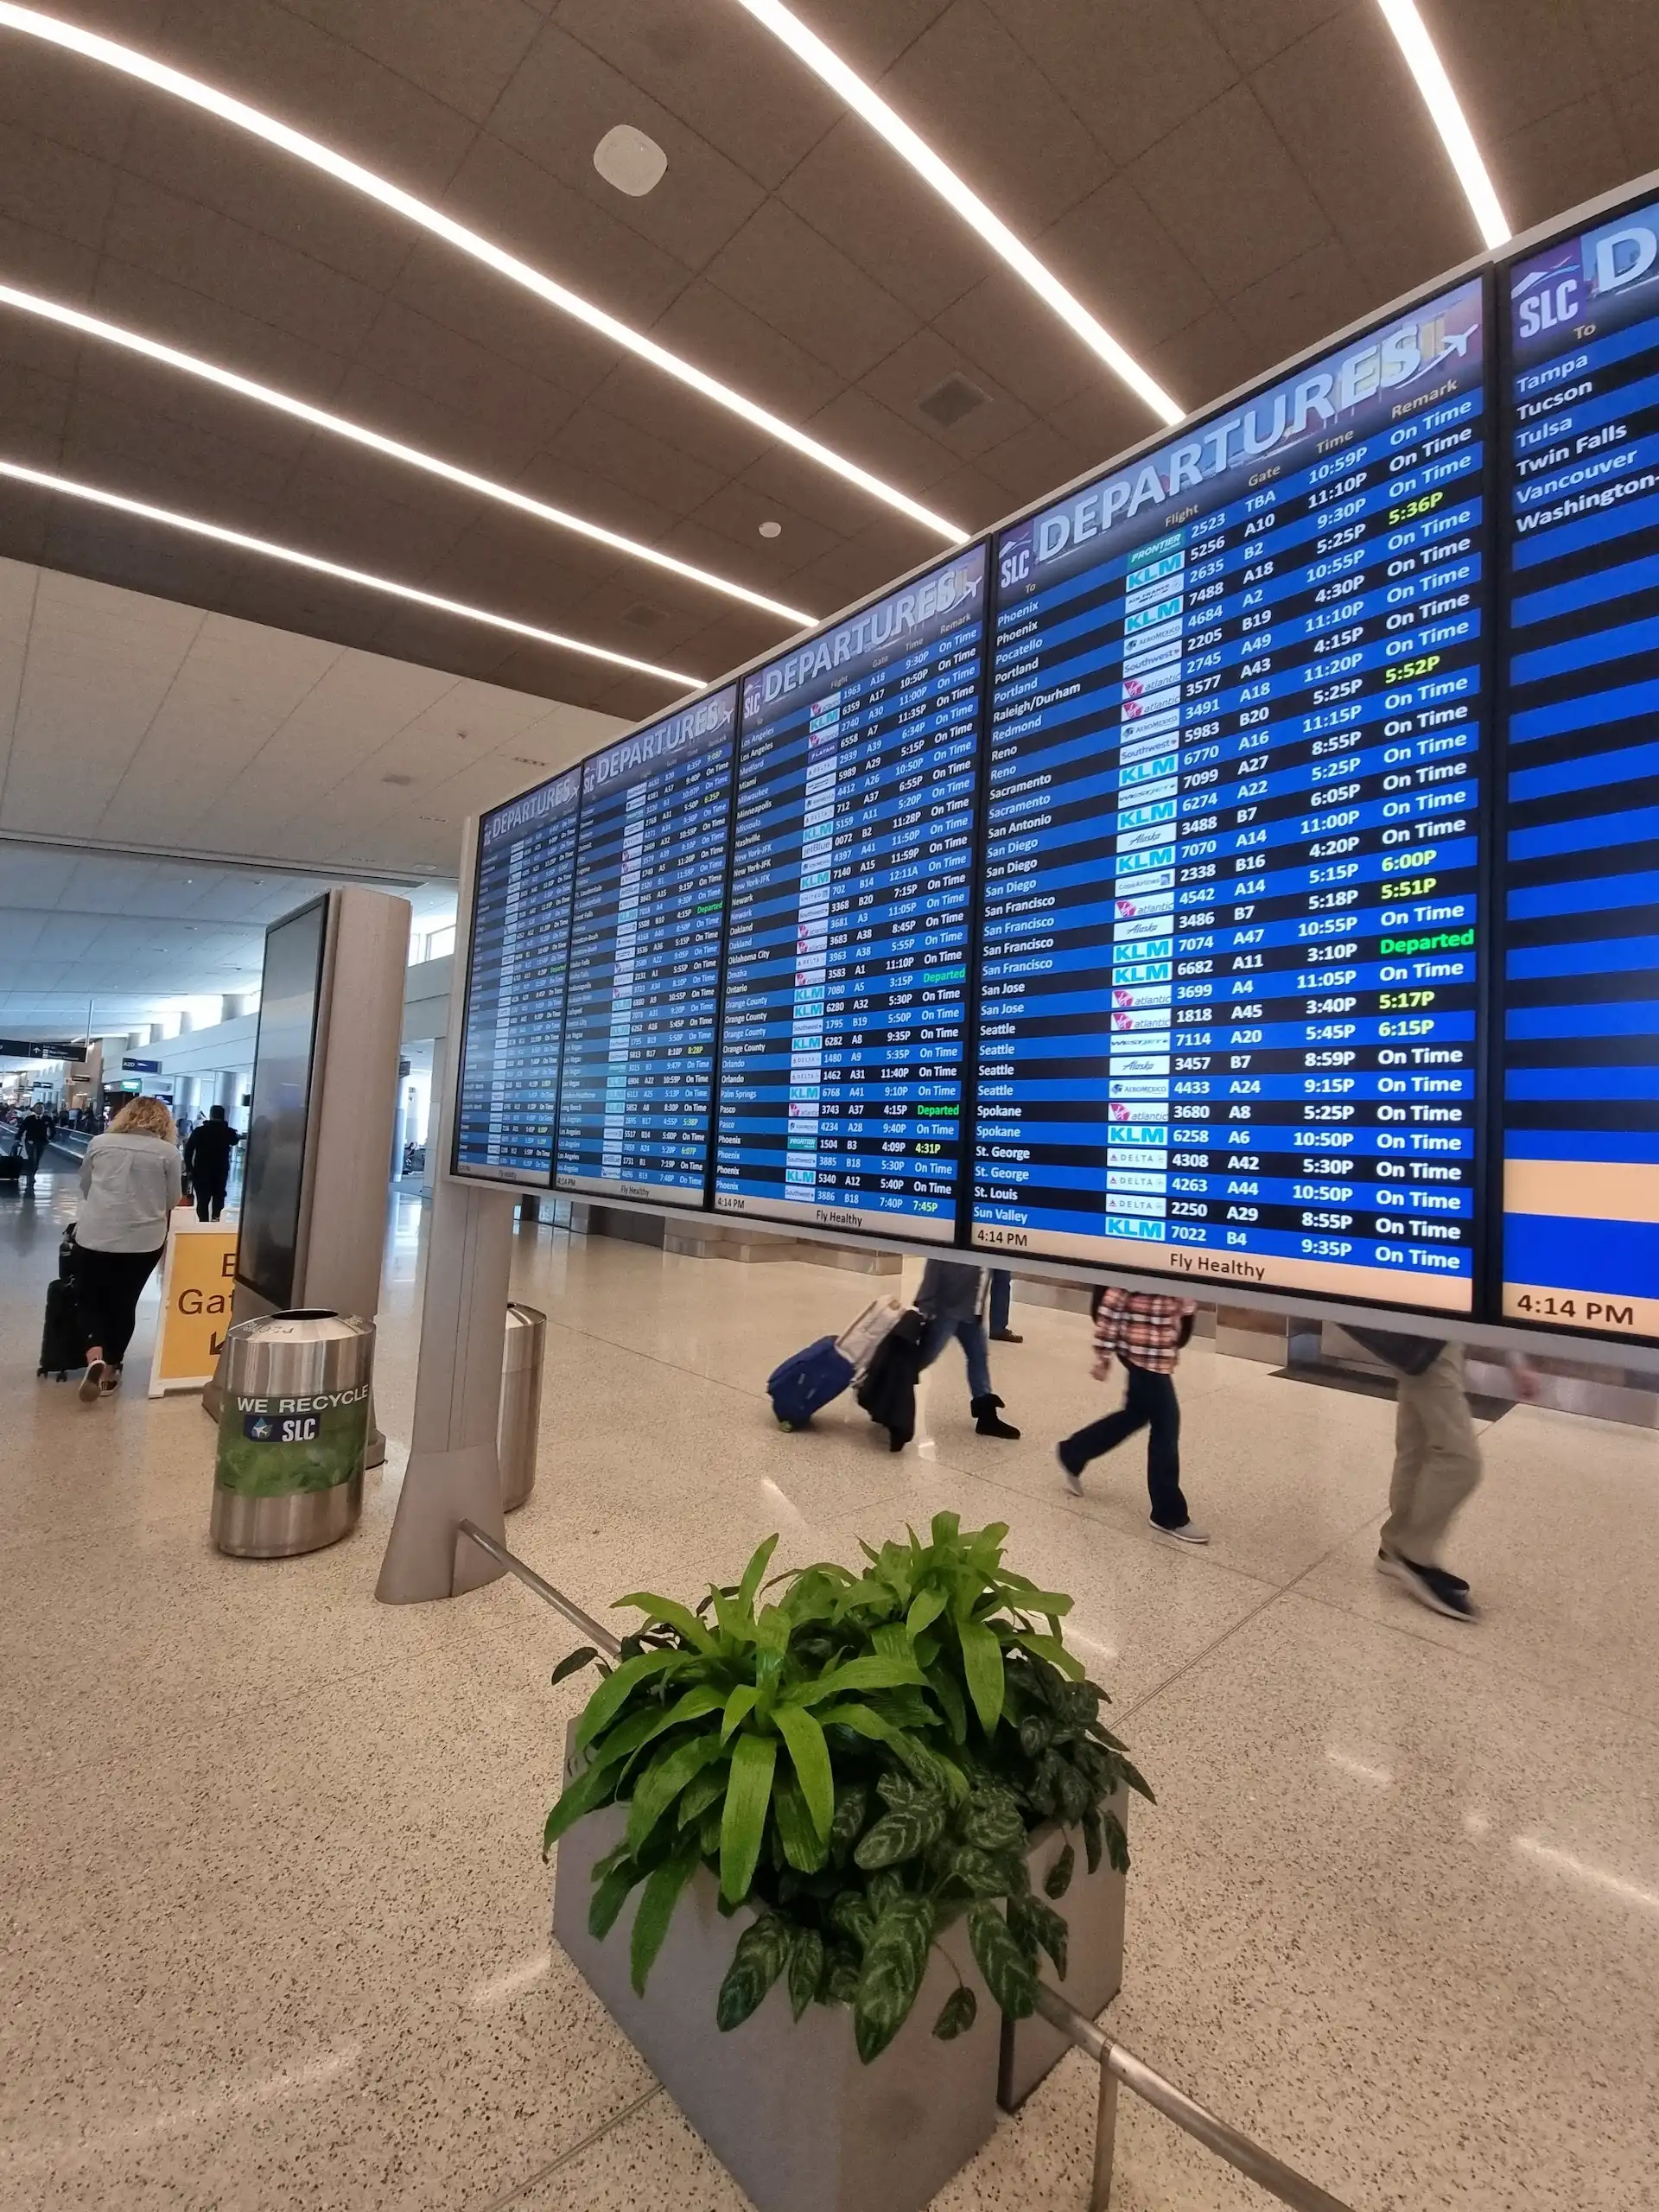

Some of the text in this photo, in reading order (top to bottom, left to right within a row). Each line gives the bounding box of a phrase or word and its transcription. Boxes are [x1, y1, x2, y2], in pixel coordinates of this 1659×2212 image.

[1519, 280, 1580, 339] SLC
[1574, 323, 1597, 340] To
[1517, 354, 1589, 393] Tampa
[1516, 381, 1592, 421] Tucson
[1039, 324, 1421, 559] DEPARTURES
[1516, 423, 1628, 476] Twin Falls
[1517, 418, 1573, 448] Tulsa
[1025, 379, 1458, 593] To Flight Gate Time Remark
[1516, 449, 1637, 505] Vancouver
[998, 402, 1471, 626] Phoenix FRONTIER 2523 TBA 10:59P On Time
[995, 657, 1039, 684] Portland
[1124, 599, 1179, 631] KLM
[1189, 582, 1224, 606] 7488
[1243, 562, 1274, 584] A18
[1317, 524, 1366, 554] 5:25P
[1389, 492, 1443, 524] 5:36P
[1001, 550, 1029, 588] SLC
[765, 570, 957, 702] DEPARTURES
[872, 654, 889, 668] Gate
[906, 637, 924, 652] Time
[940, 613, 971, 634] Remark
[994, 538, 1471, 722] Raleigh/Durham Southwest 2205 B19 4:30P On Time
[741, 753, 750, 762] Los
[750, 742, 773, 758] Angeles
[842, 700, 860, 715] 6359
[869, 689, 885, 703] A17
[900, 669, 928, 690] 10:50P
[938, 659, 951, 671] On
[953, 648, 976, 664] Time
[744, 694, 760, 718] SLC
[597, 701, 718, 784] DEPARTURES
[989, 656, 1440, 800] Sacramento Southwest 5983 B20 5:25P 5:52P
[493, 779, 570, 838] DEPARTURES
[986, 762, 1466, 878] San Diego Alaska 3488 B7 6:05P On Time
[984, 849, 1437, 937] San Francisco atlantic 4542 A14 5:15P 6:00P
[982, 928, 1474, 995] San Jose KLM 6682 A11 3:10P Departed
[726, 1001, 746, 1009] Orange
[747, 997, 767, 1007] County
[828, 985, 845, 995] 7080
[854, 982, 865, 992] A5
[889, 976, 913, 988] 3:15P
[923, 968, 965, 983] Departed
[980, 991, 1435, 1036] Seattle atlantic 1818 A45 3:40P 5:17P
[718, 1135, 741, 1144] Phoenix
[820, 1139, 837, 1148] 1504
[847, 1141, 857, 1150] B3
[881, 1141, 906, 1152] 4:09P
[915, 1143, 941, 1154] 4:31P
[976, 1146, 1461, 1180] St. George DELTA 4308 A42 5:30P On Time
[568, 1179, 575, 1187] PM
[631, 1186, 649, 1197] Healthy
[716, 1165, 740, 1175] Phoenix
[818, 1173, 836, 1184] 5340
[845, 1176, 861, 1186] A12
[880, 1179, 904, 1190] 5:40P
[913, 1181, 927, 1192] On
[929, 1182, 951, 1194] Time
[717, 1197, 745, 1210] 4:14 PM
[816, 1210, 862, 1227] Fly Healthy
[974, 1206, 1459, 1268] Sun Valley KLM 7022 B4 9:35P On Time
[977, 1229, 1027, 1247] 4:14 PM
[1170, 1252, 1266, 1279] Fly Healthy
[1517, 1294, 1633, 1325] 4:14 PM
[237, 1384, 369, 1414] WE RECYCLE
[282, 1418, 316, 1442] SLC
